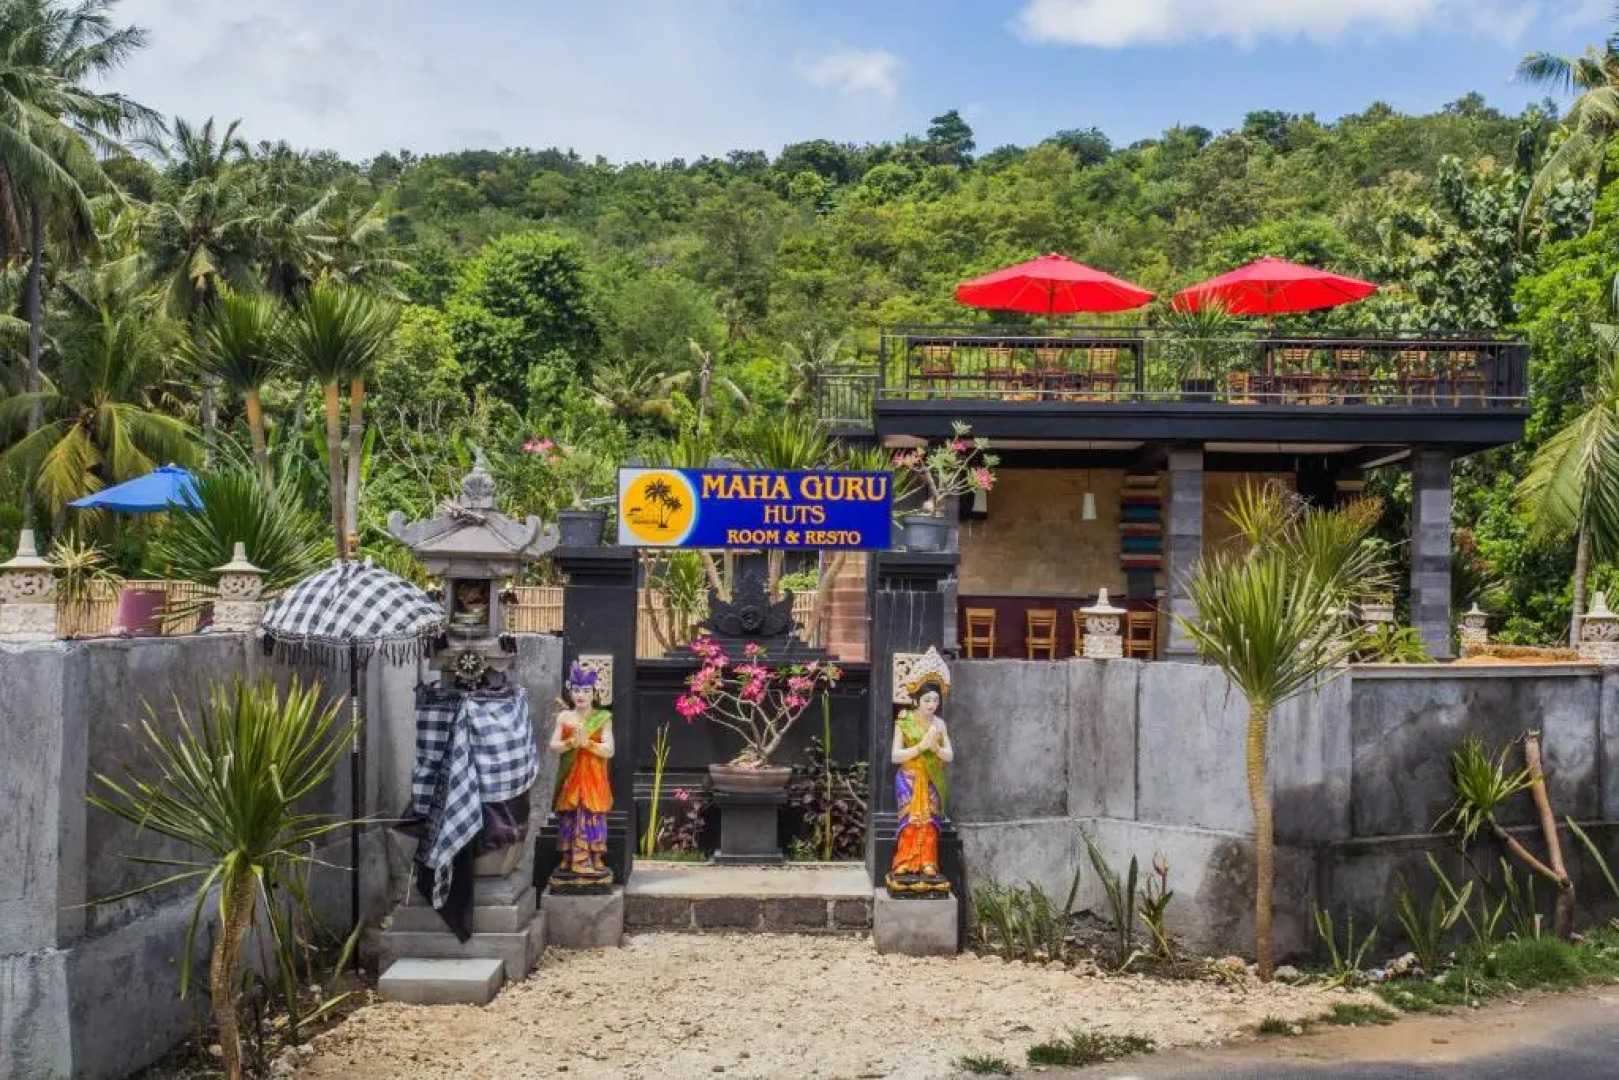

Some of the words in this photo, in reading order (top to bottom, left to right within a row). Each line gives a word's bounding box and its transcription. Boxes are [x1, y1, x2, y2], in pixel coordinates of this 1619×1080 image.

[701, 474, 791, 500] MAHA
[799, 475, 887, 501] GURU
[764, 505, 826, 524] HUTS
[726, 529, 780, 545] ROOM
[785, 530, 800, 545] &
[805, 530, 861, 545] RESTO
